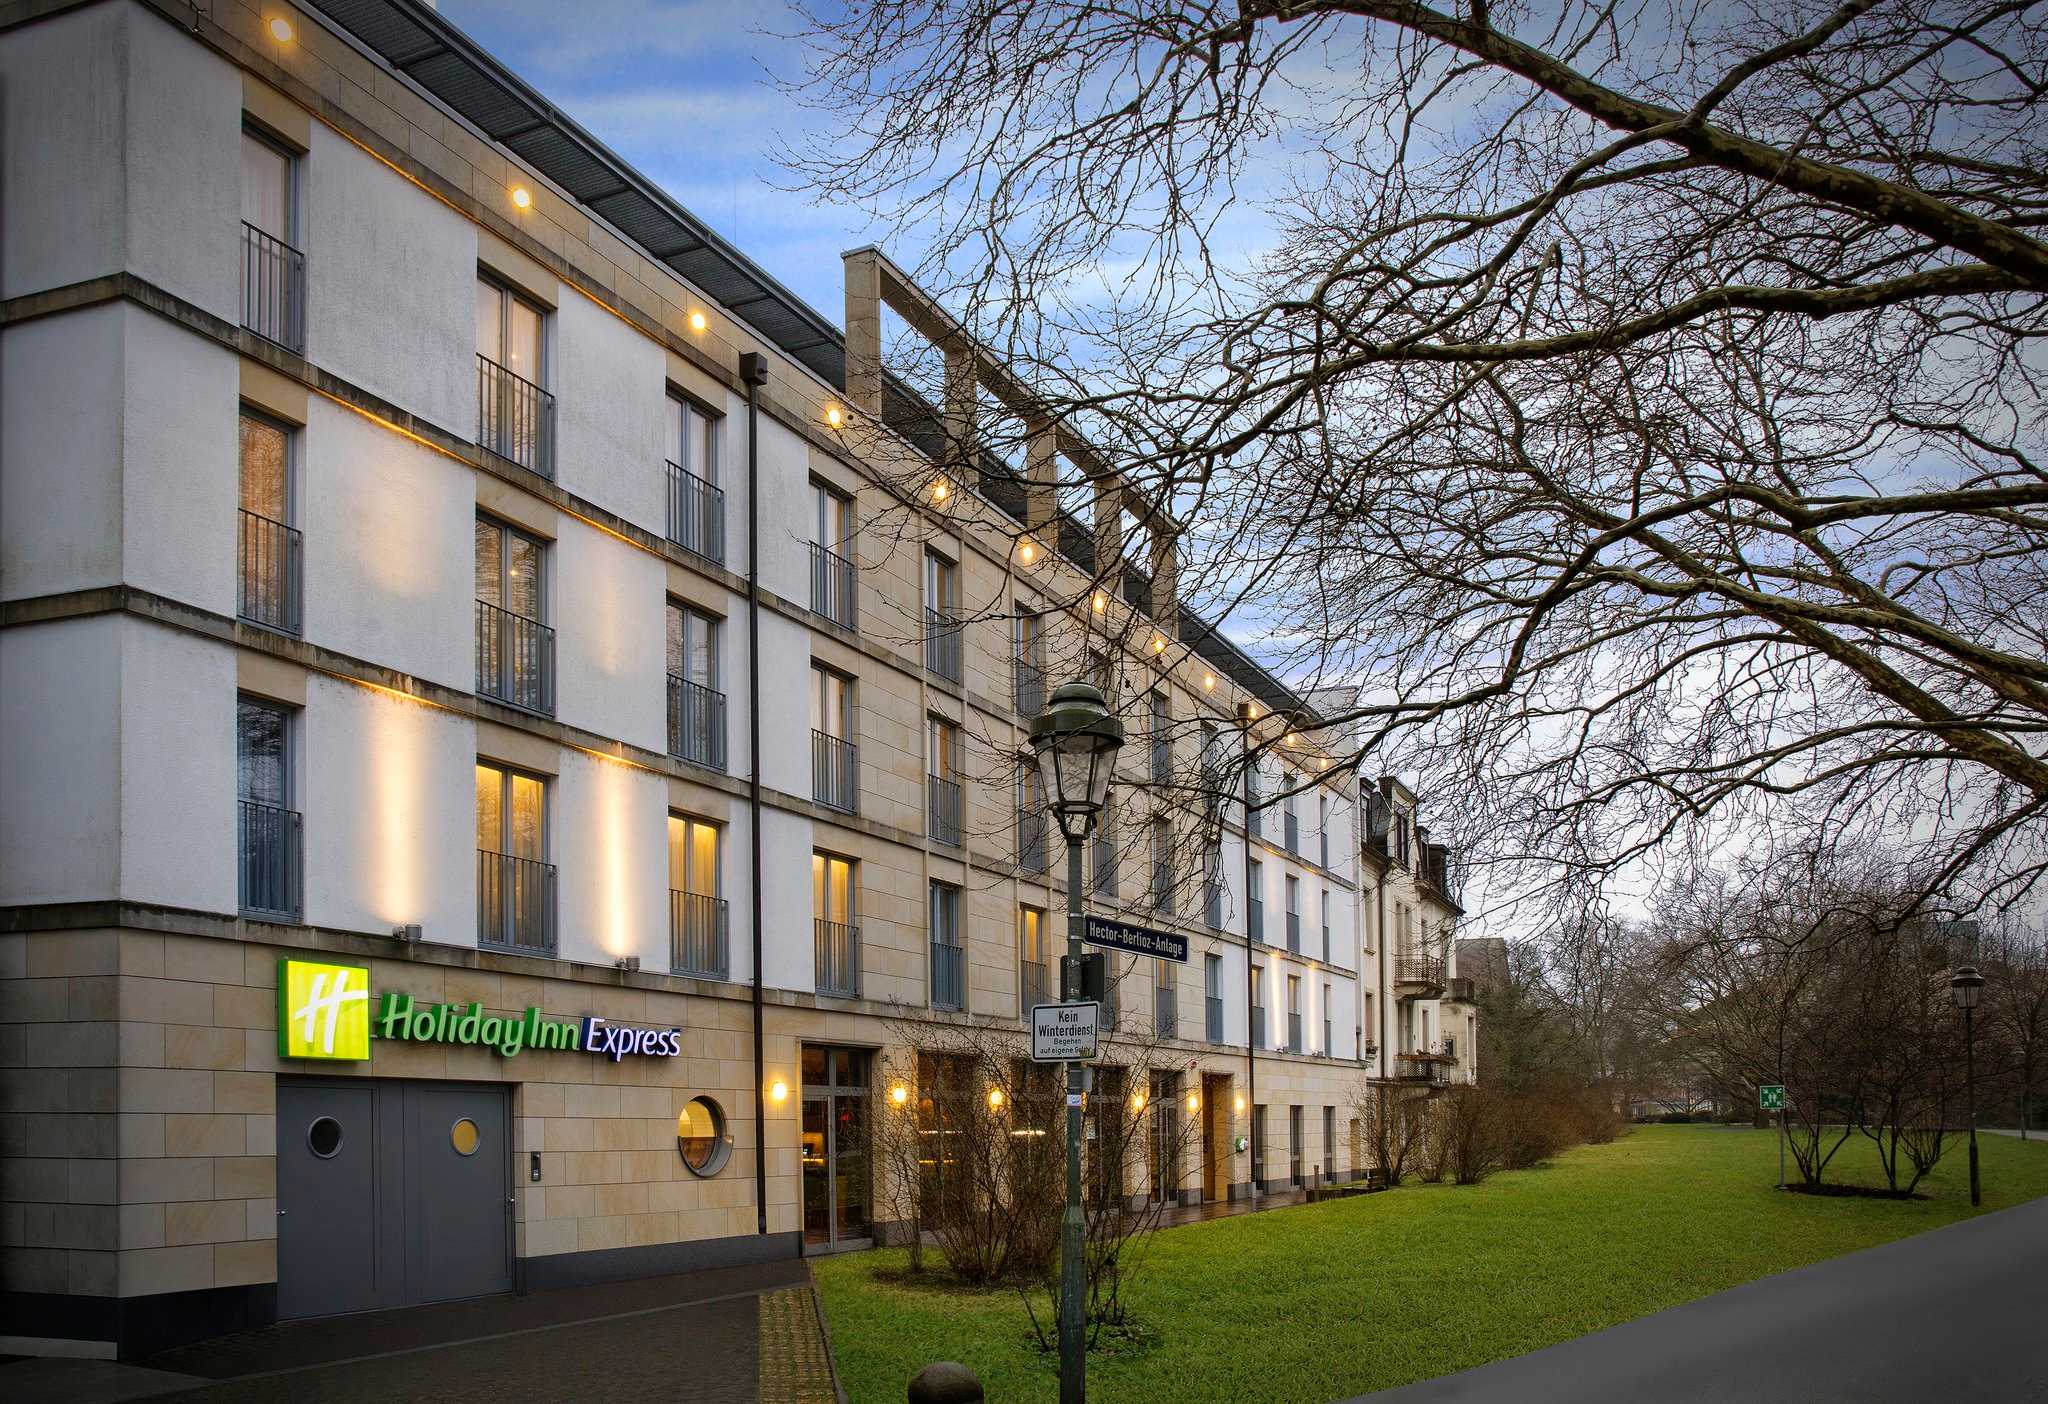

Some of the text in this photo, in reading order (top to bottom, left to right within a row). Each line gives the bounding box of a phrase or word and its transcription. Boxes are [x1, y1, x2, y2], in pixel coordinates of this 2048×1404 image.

[1089, 921, 1183, 957] Hector-Berlioz-Anlage
[1058, 1010, 1078, 1022] Kein
[379, 993, 681, 1062] Holiday Inn Express
[1038, 1023, 1094, 1037] Winterdienst
[1053, 1038, 1081, 1046] Begehen
[1051, 1047, 1074, 1055] eigene
